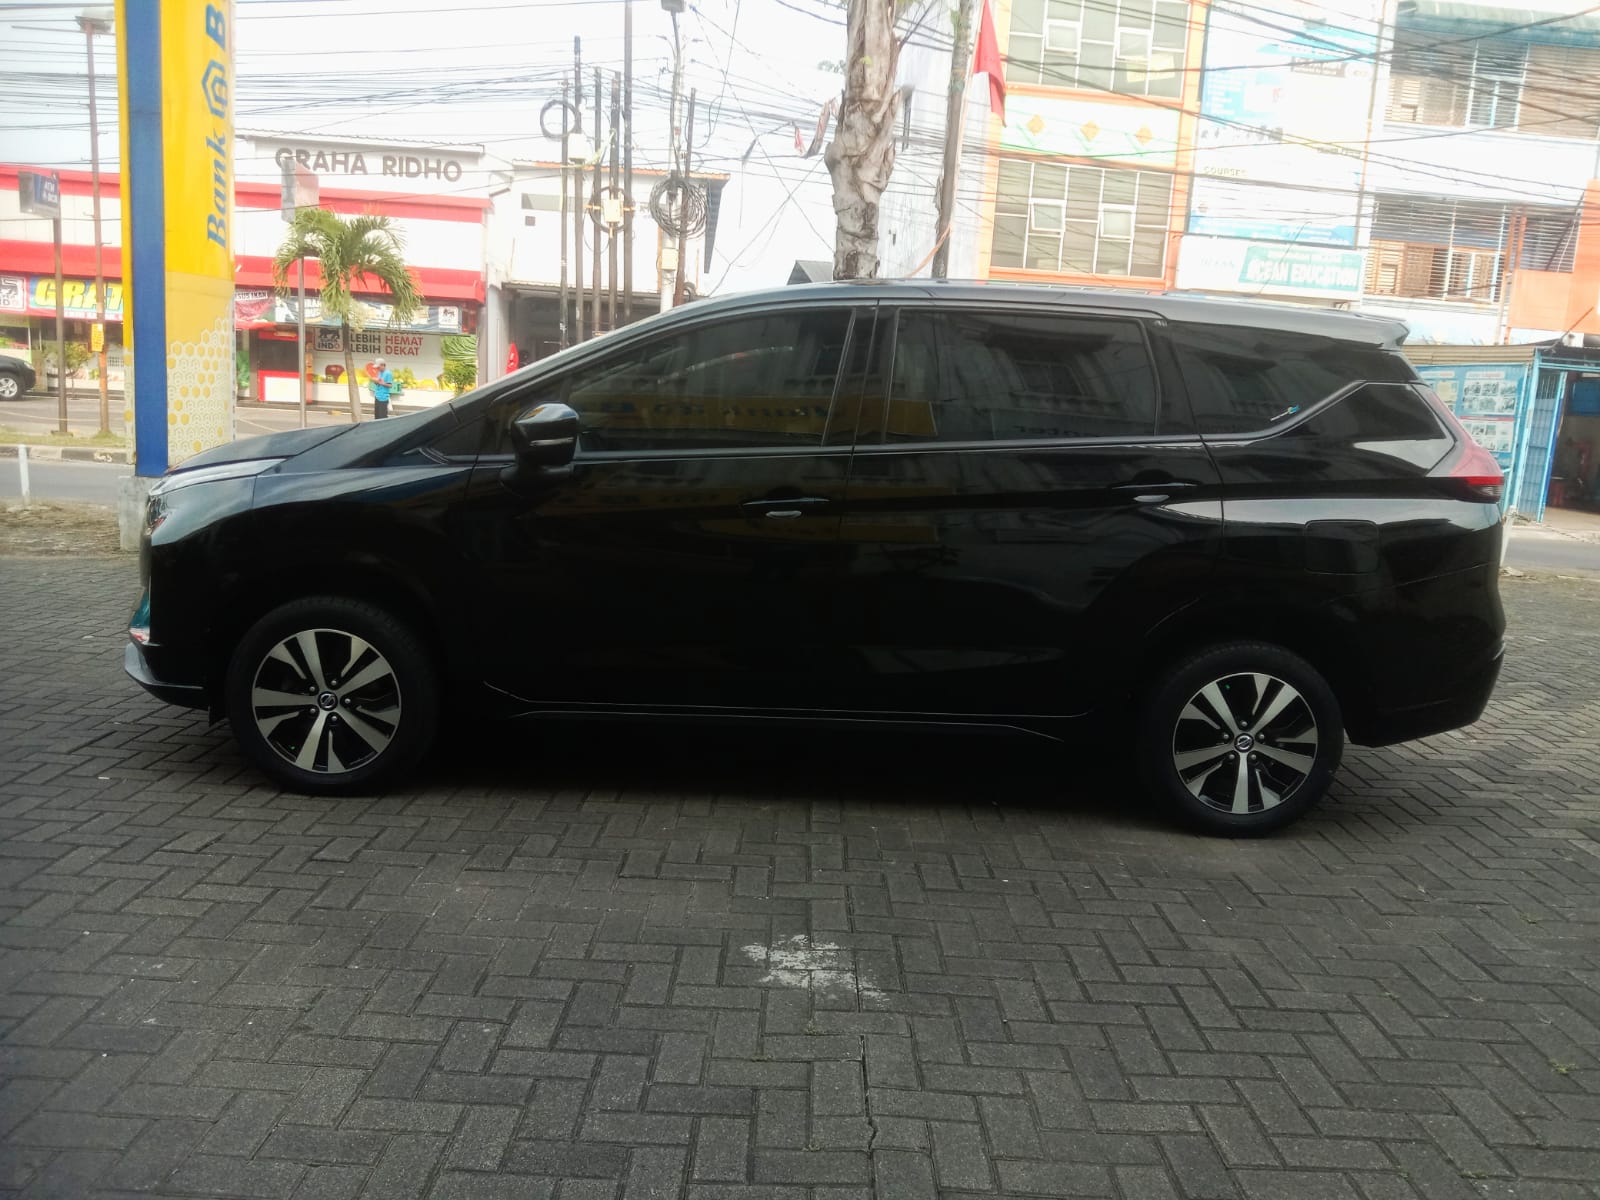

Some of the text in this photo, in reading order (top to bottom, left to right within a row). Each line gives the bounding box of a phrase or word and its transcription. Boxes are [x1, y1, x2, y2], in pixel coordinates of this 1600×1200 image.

[275, 147, 462, 182] GRAHA RIDHO
[206, 128, 226, 249] Bank
[1247, 257, 1289, 282] OCEAN
[1290, 262, 1359, 287] EDUCATION
[350, 333, 381, 344] LEBIH
[385, 335, 424, 346] HEMAT
[350, 344, 420, 356] LEBIH DEKAT
